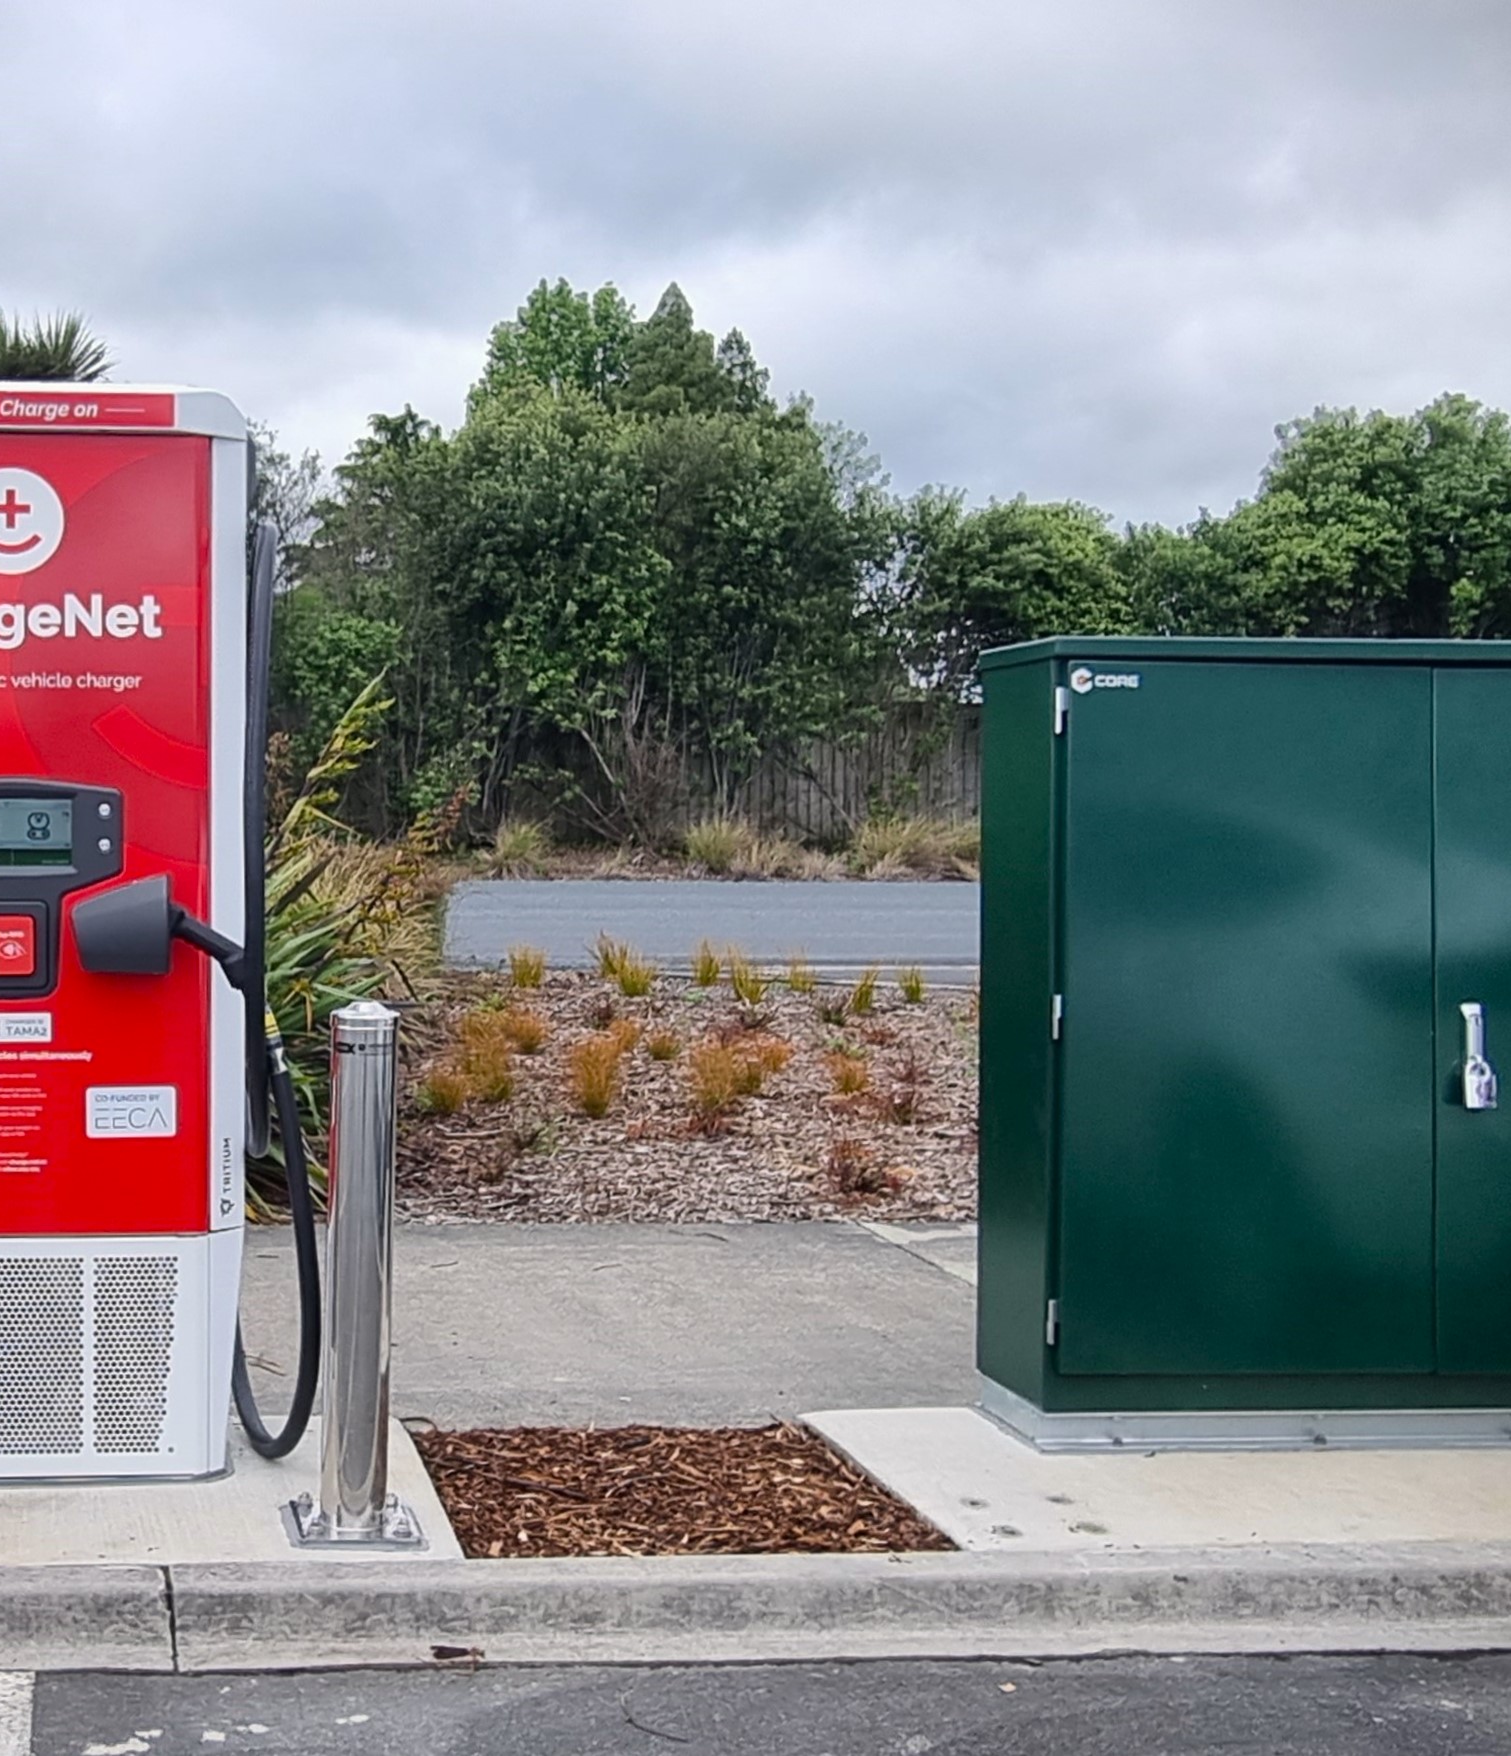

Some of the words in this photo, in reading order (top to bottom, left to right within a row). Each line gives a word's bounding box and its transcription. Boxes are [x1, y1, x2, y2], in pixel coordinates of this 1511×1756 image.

[0, 399, 67, 421] Charge
[74, 404, 98, 417] on
[11, 672, 72, 688] vehicle
[76, 672, 142, 691] charger
[95, 1107, 167, 1129] EECA
[223, 1137, 232, 1194] TRITIUM
